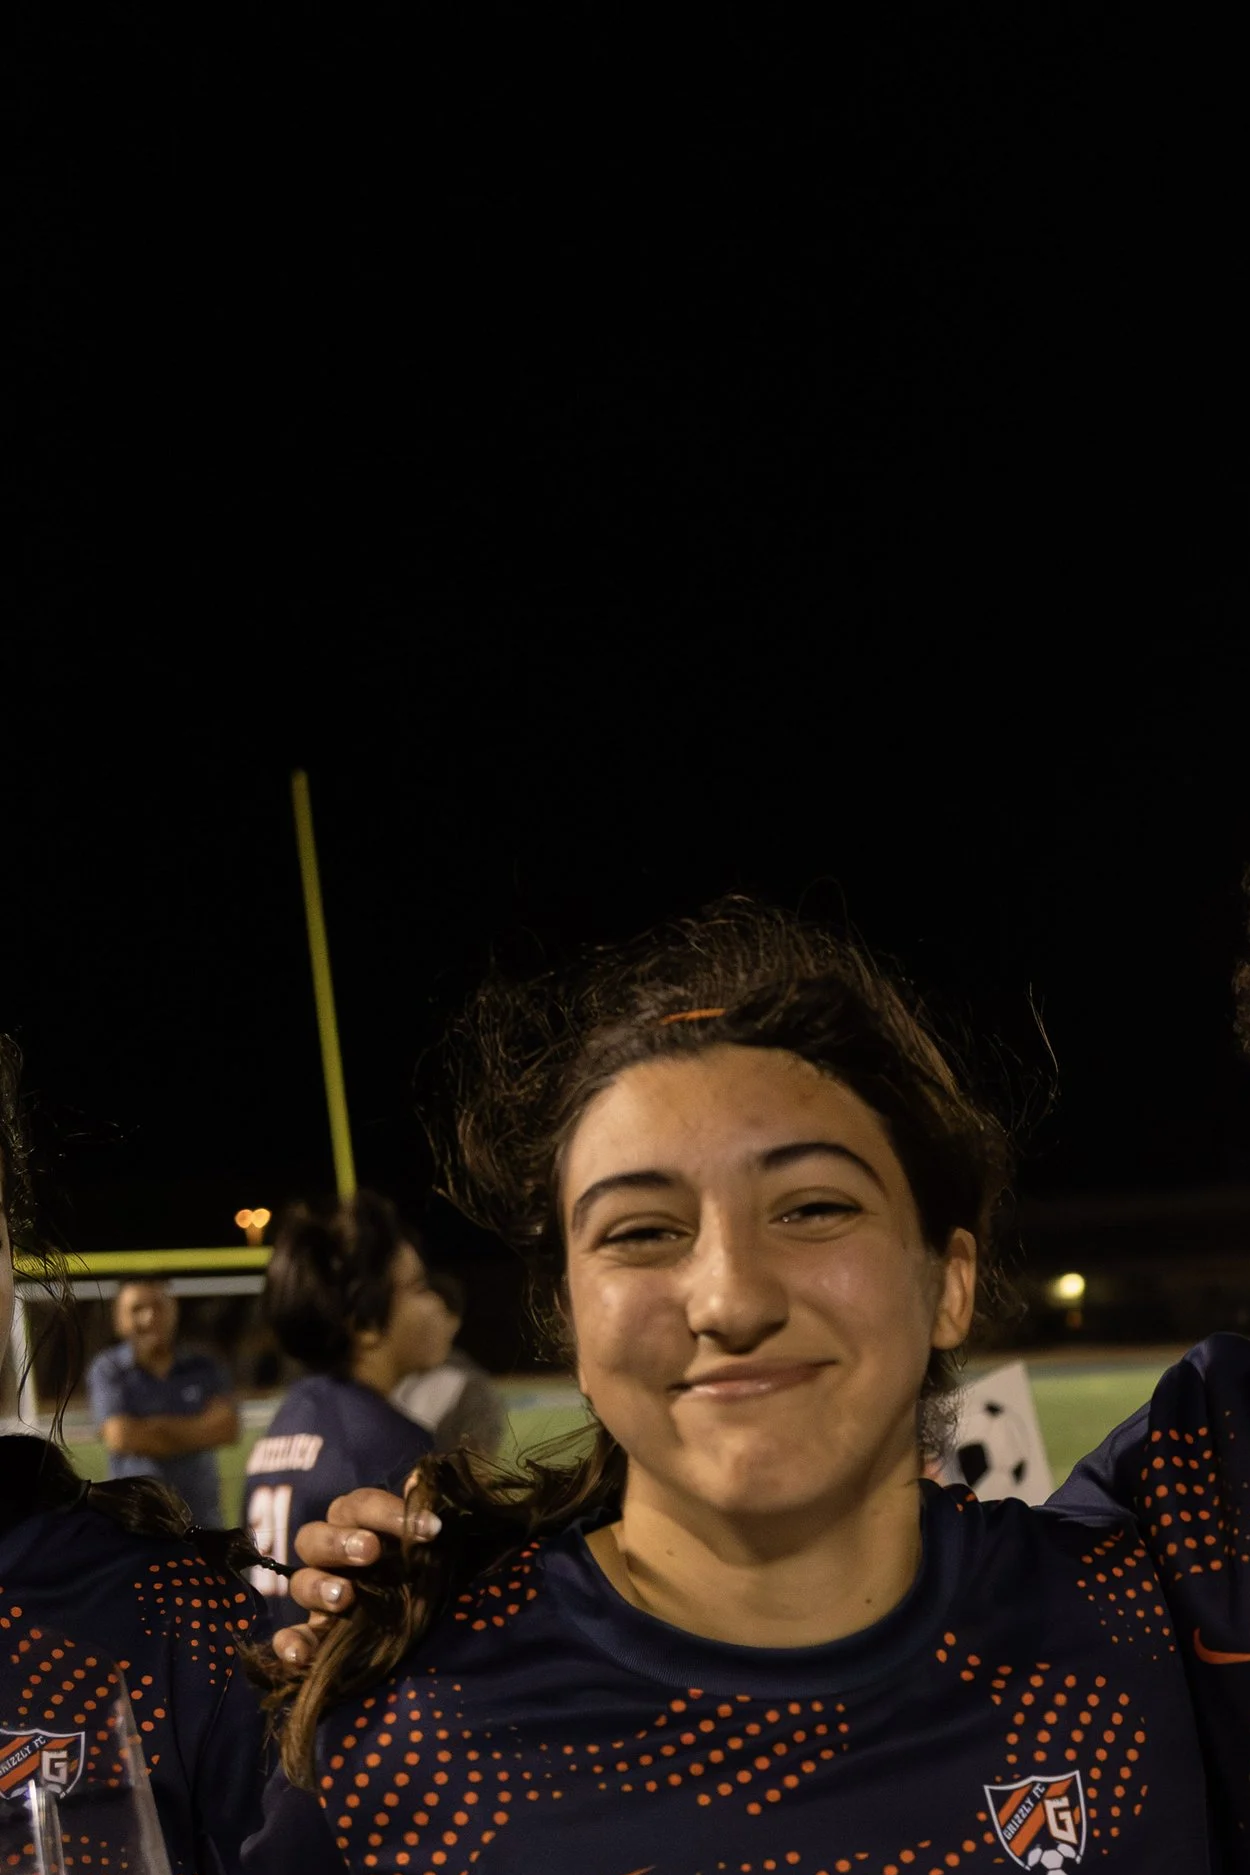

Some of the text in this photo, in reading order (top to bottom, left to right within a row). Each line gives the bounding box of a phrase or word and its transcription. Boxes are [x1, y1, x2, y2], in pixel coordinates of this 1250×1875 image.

[33, 1735, 48, 1749] FC
[41, 1750, 68, 1785] G
[1002, 1782, 1047, 1841] GRIZZLY FC
[1042, 1795, 1079, 1844] G
